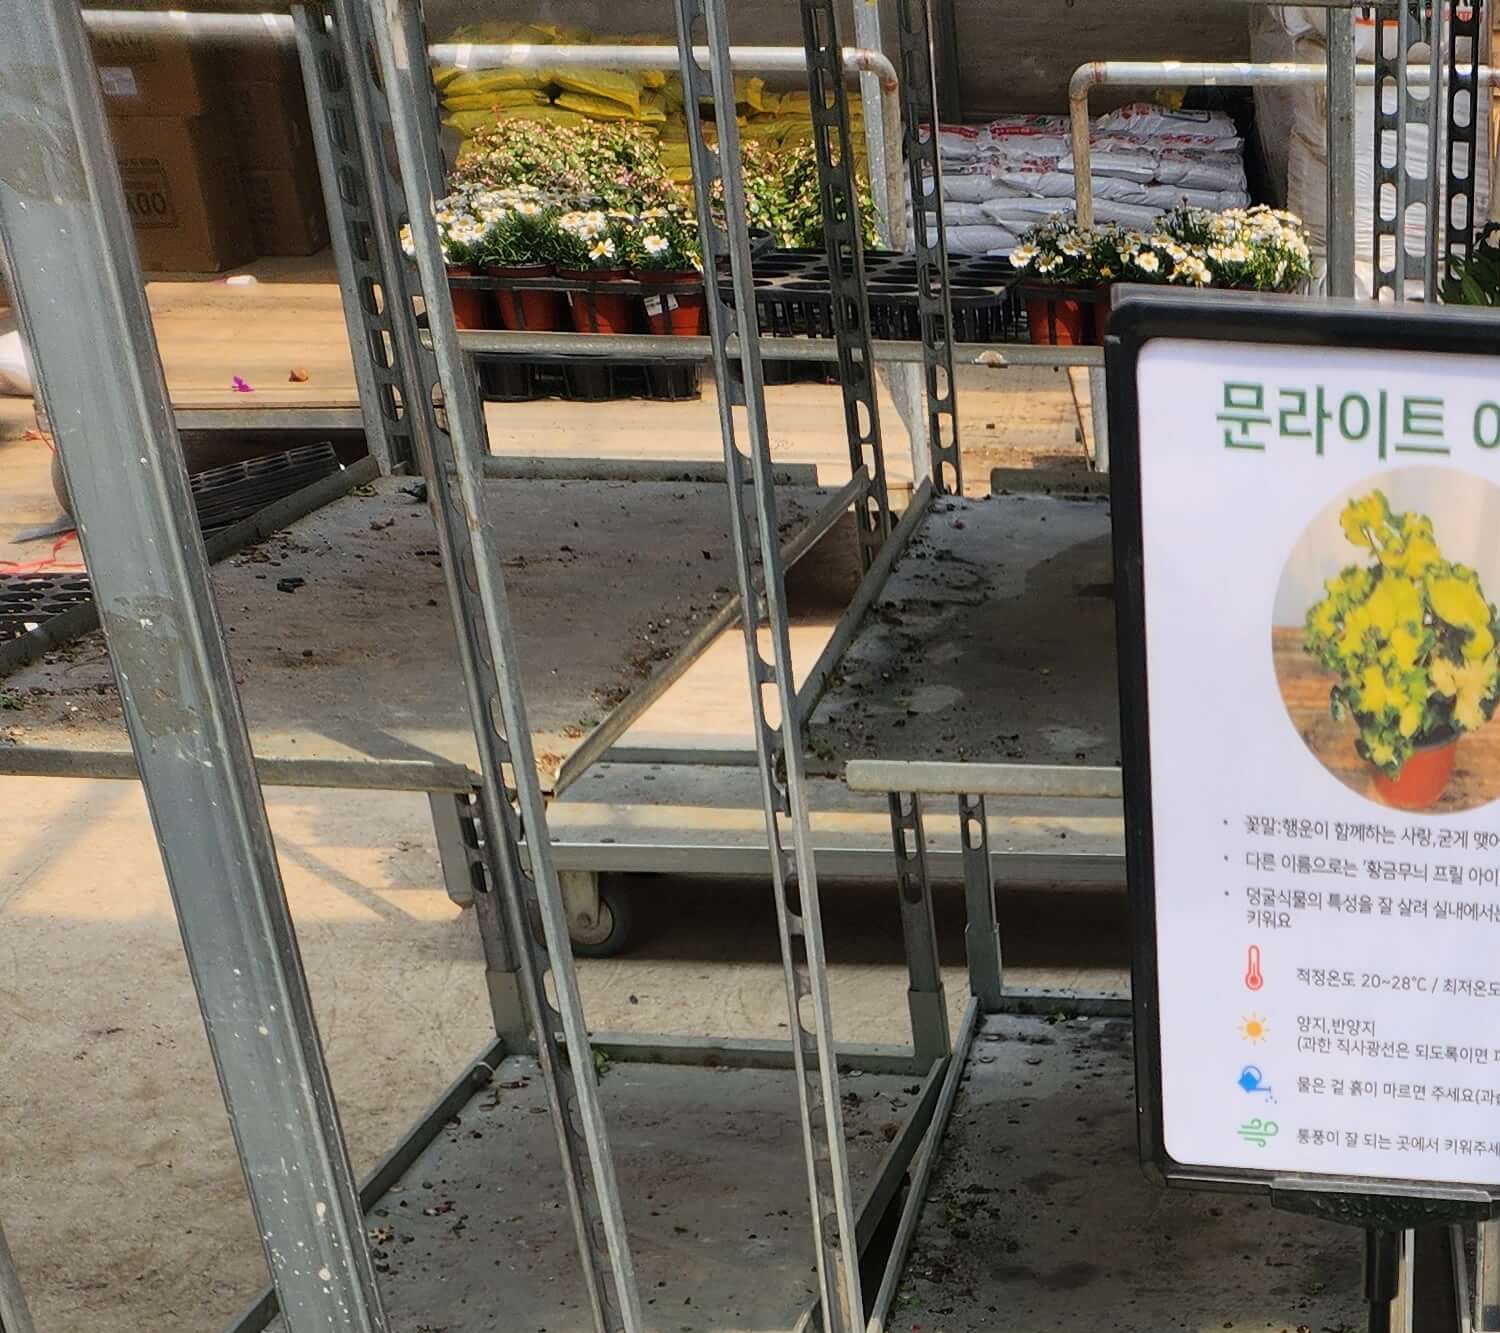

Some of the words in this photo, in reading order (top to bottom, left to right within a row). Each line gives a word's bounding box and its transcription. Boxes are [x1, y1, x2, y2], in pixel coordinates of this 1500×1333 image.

[1216, 381, 1451, 461] 문라이트
[1245, 815, 1329, 840] 꽃말:행운이
[1335, 821, 1396, 844] 함께하는
[1401, 826, 1469, 850] 사랑,굳게
[1246, 851, 1276, 871] 다른
[1281, 854, 1359, 877] 이름으로는
[1433, 864, 1464, 885] 프릴
[1246, 887, 1322, 910] 덩굴식물의
[1327, 893, 1374, 914] 특성을
[1378, 896, 1394, 915] 잘
[1397, 898, 1428, 918] 살려
[1247, 910, 1292, 929] 키워요
[1296, 967, 1356, 988] 적정온도
[1297, 1015, 1376, 1037] 양지,반양지
[1297, 1036, 1331, 1054] (과한
[1336, 1038, 1410, 1059] 직사광선은
[1415, 1043, 1489, 1064] 되도록이면
[1297, 1076, 1326, 1094] 물은
[1350, 1080, 1378, 1098] 흙이
[1383, 1082, 1427, 1101] 마르면
[1297, 1128, 1340, 1146] 통풍이
[1345, 1131, 1358, 1148] 잘
[1363, 1133, 1393, 1150] 되는
[1396, 1135, 1439, 1153] 곳에서
